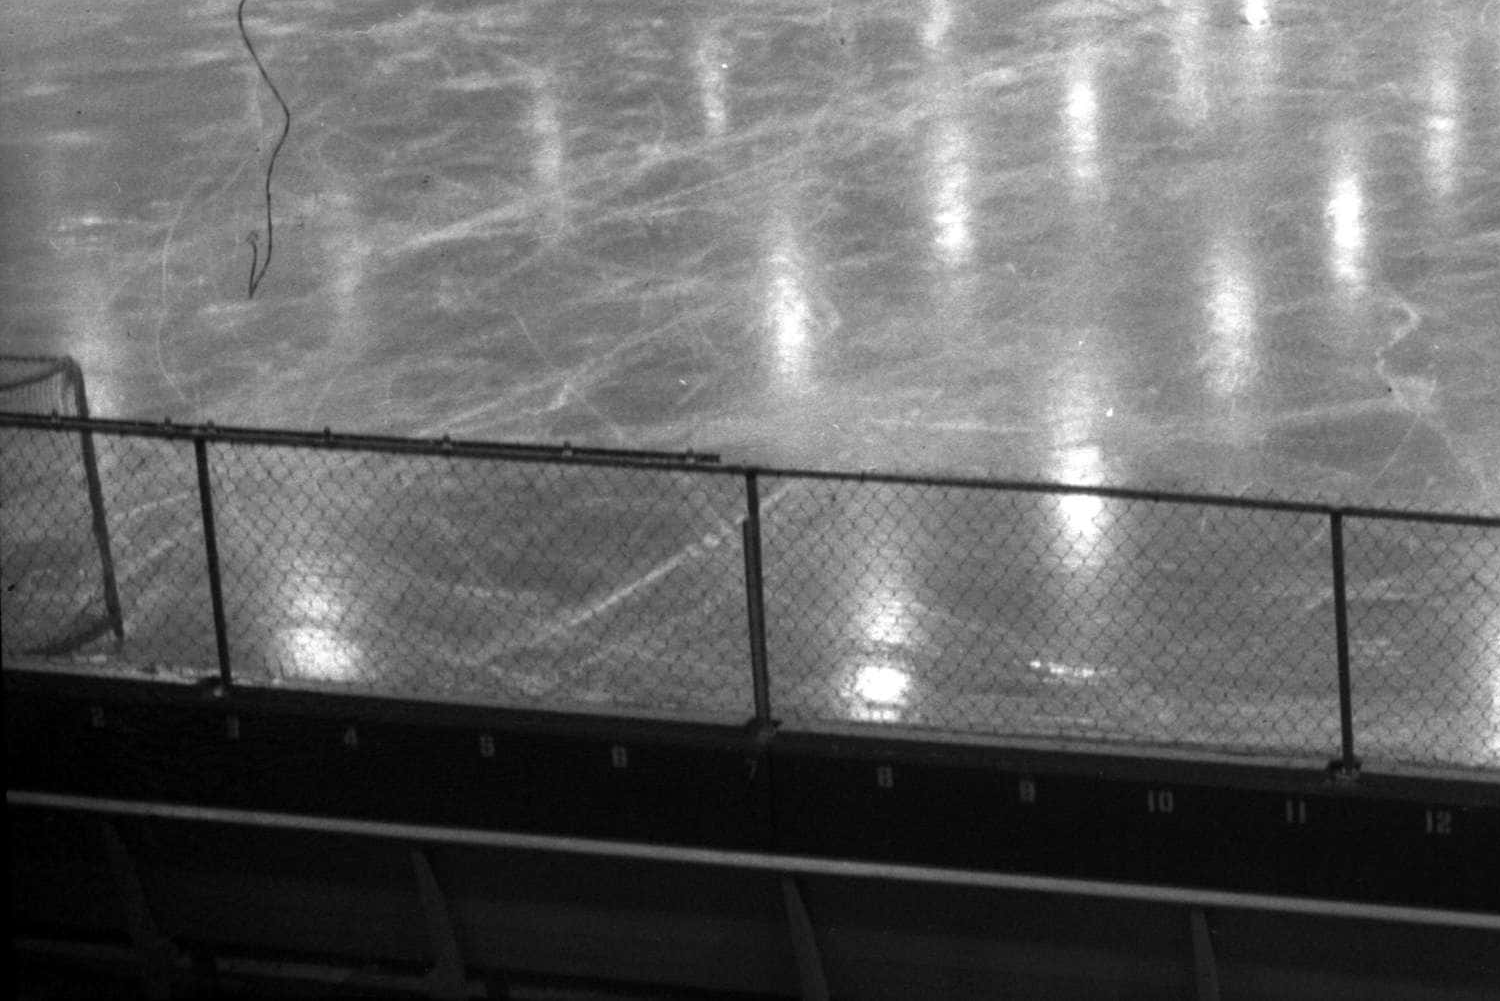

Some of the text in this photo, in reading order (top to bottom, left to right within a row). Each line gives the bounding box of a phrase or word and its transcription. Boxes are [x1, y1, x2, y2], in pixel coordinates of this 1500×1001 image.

[1148, 790, 1173, 814] 10
[1286, 800, 1306, 824] 11
[1426, 811, 1451, 835] 12
